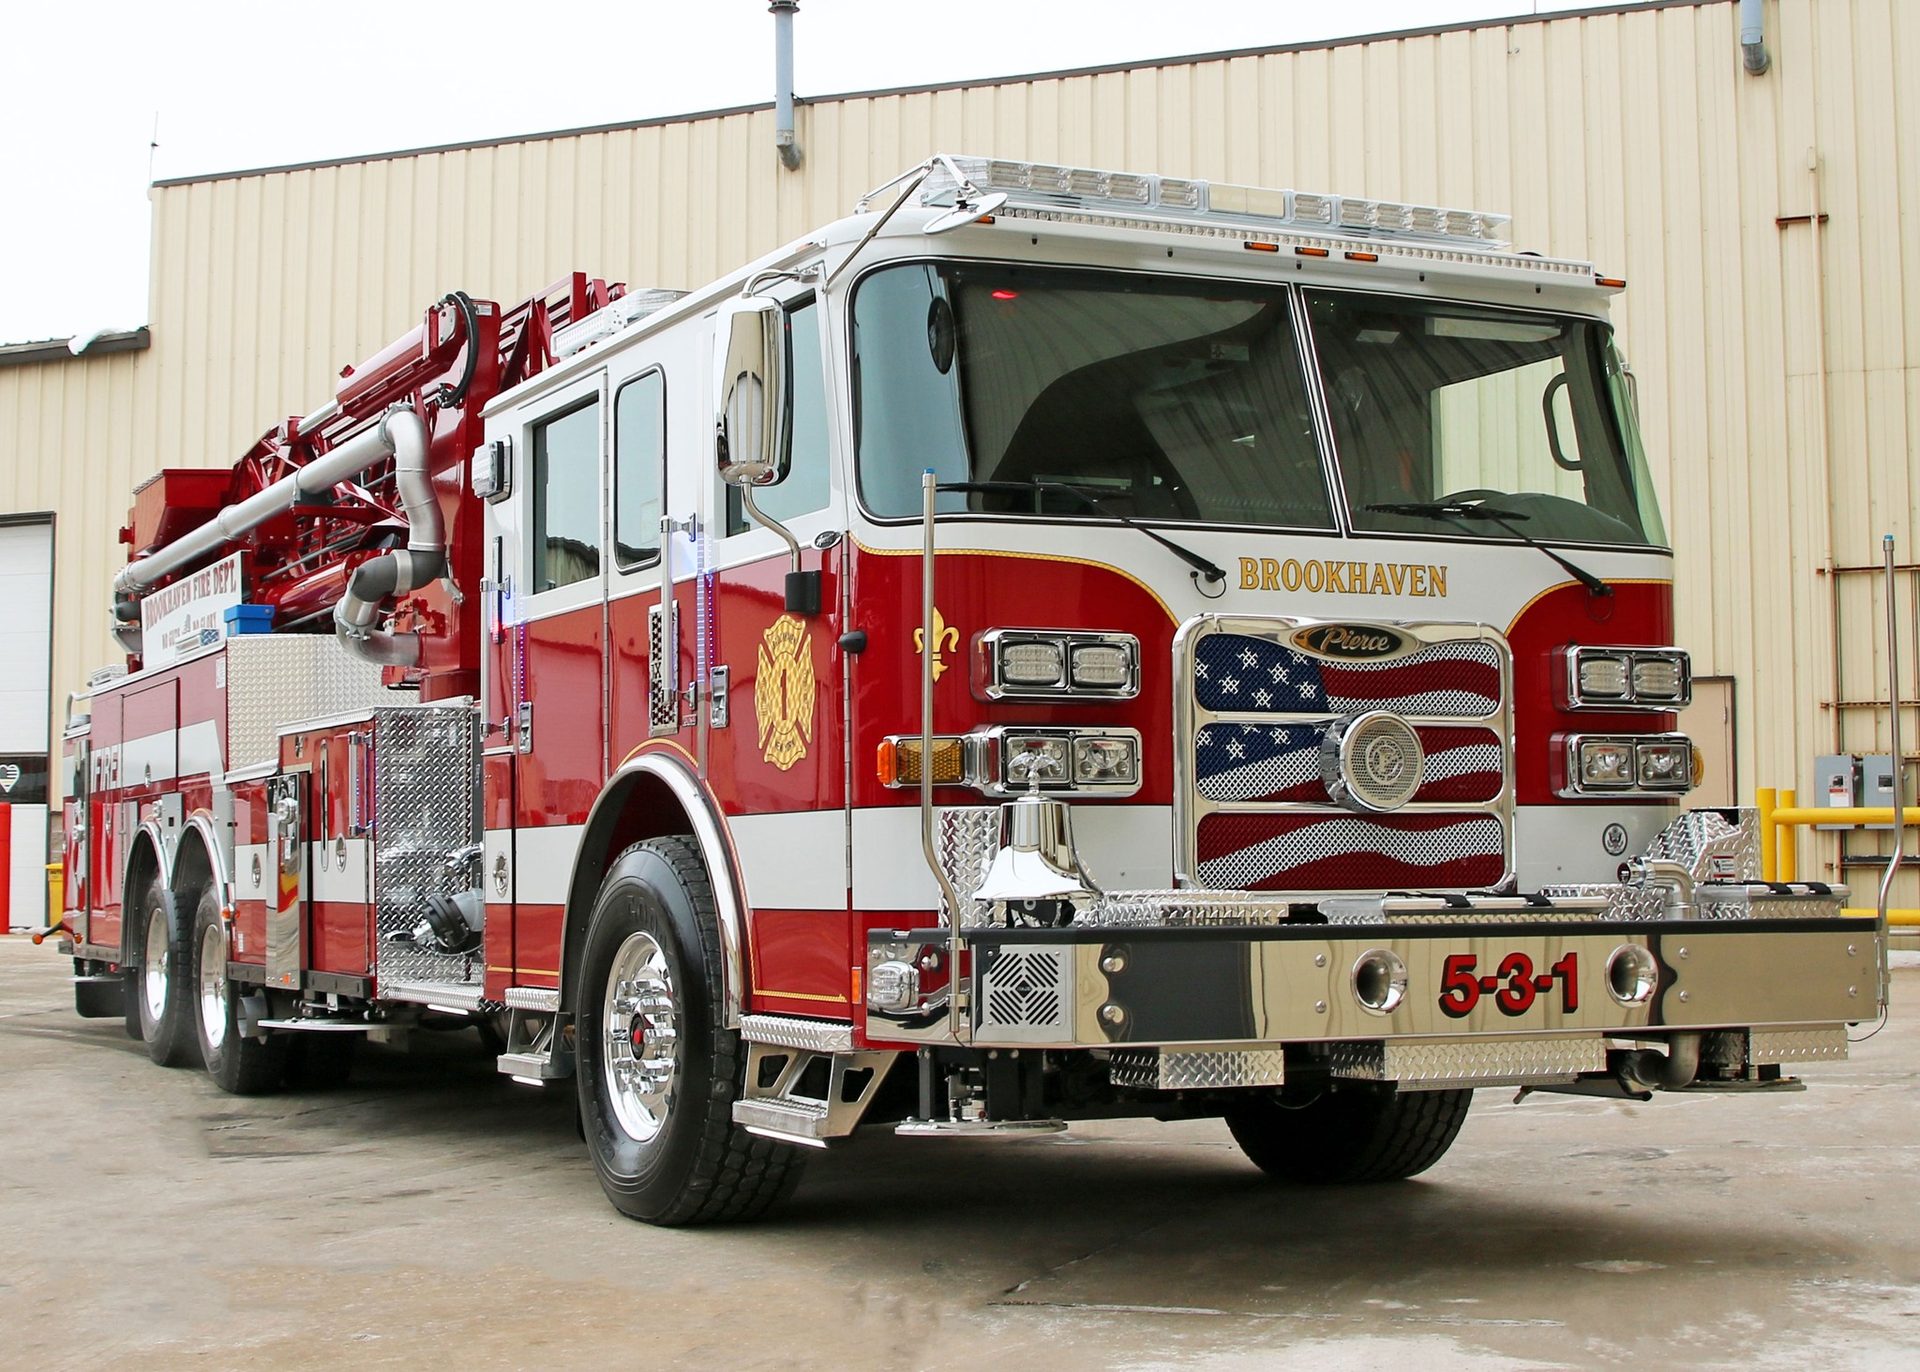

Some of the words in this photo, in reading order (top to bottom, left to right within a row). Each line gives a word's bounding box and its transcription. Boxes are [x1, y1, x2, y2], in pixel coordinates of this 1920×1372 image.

[193, 570, 211, 600] FIRE
[1238, 556, 1448, 598] BROOKHAVEN
[1320, 626, 1391, 656] Pierce
[779, 668, 787, 721] 1
[93, 745, 119, 792] FIRE
[1438, 952, 1579, 1019] 5-3-1
